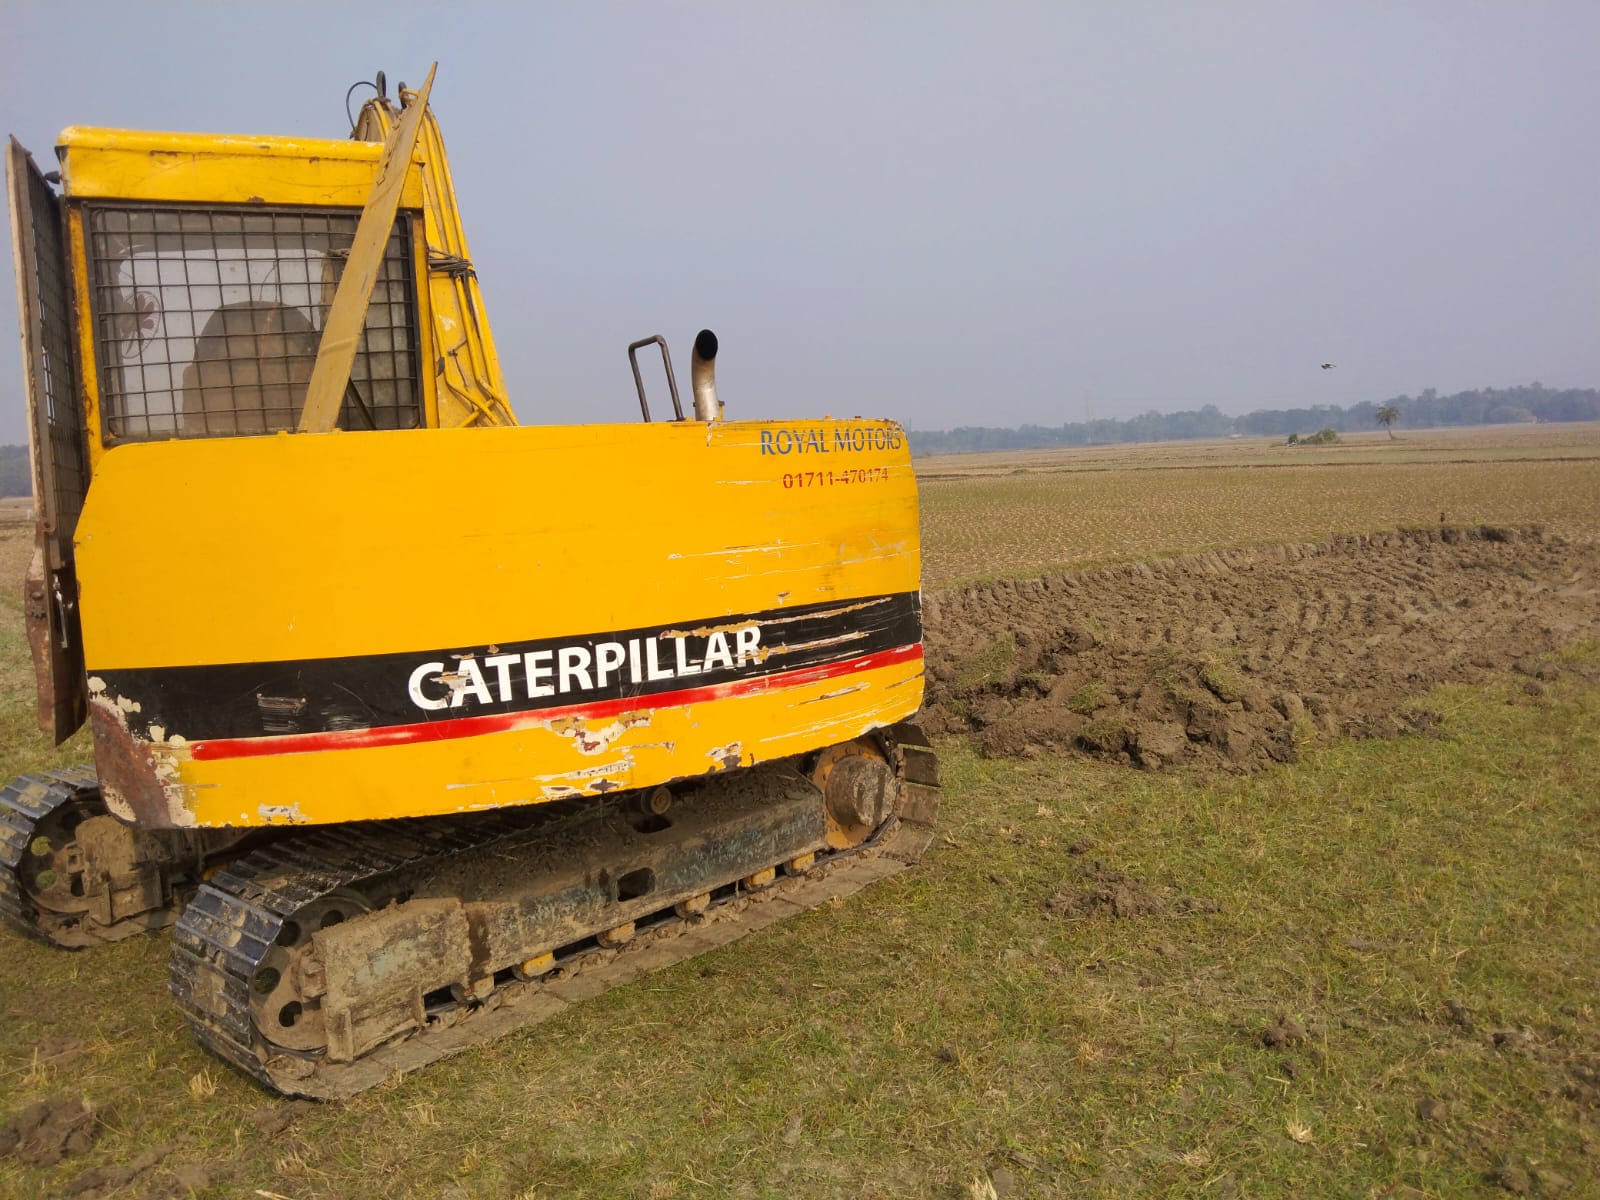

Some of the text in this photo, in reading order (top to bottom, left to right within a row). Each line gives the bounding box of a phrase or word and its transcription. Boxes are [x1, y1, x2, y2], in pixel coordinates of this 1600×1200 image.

[760, 427, 901, 455] ROYAL MOTORS
[408, 625, 763, 711] CATERPILLAR
